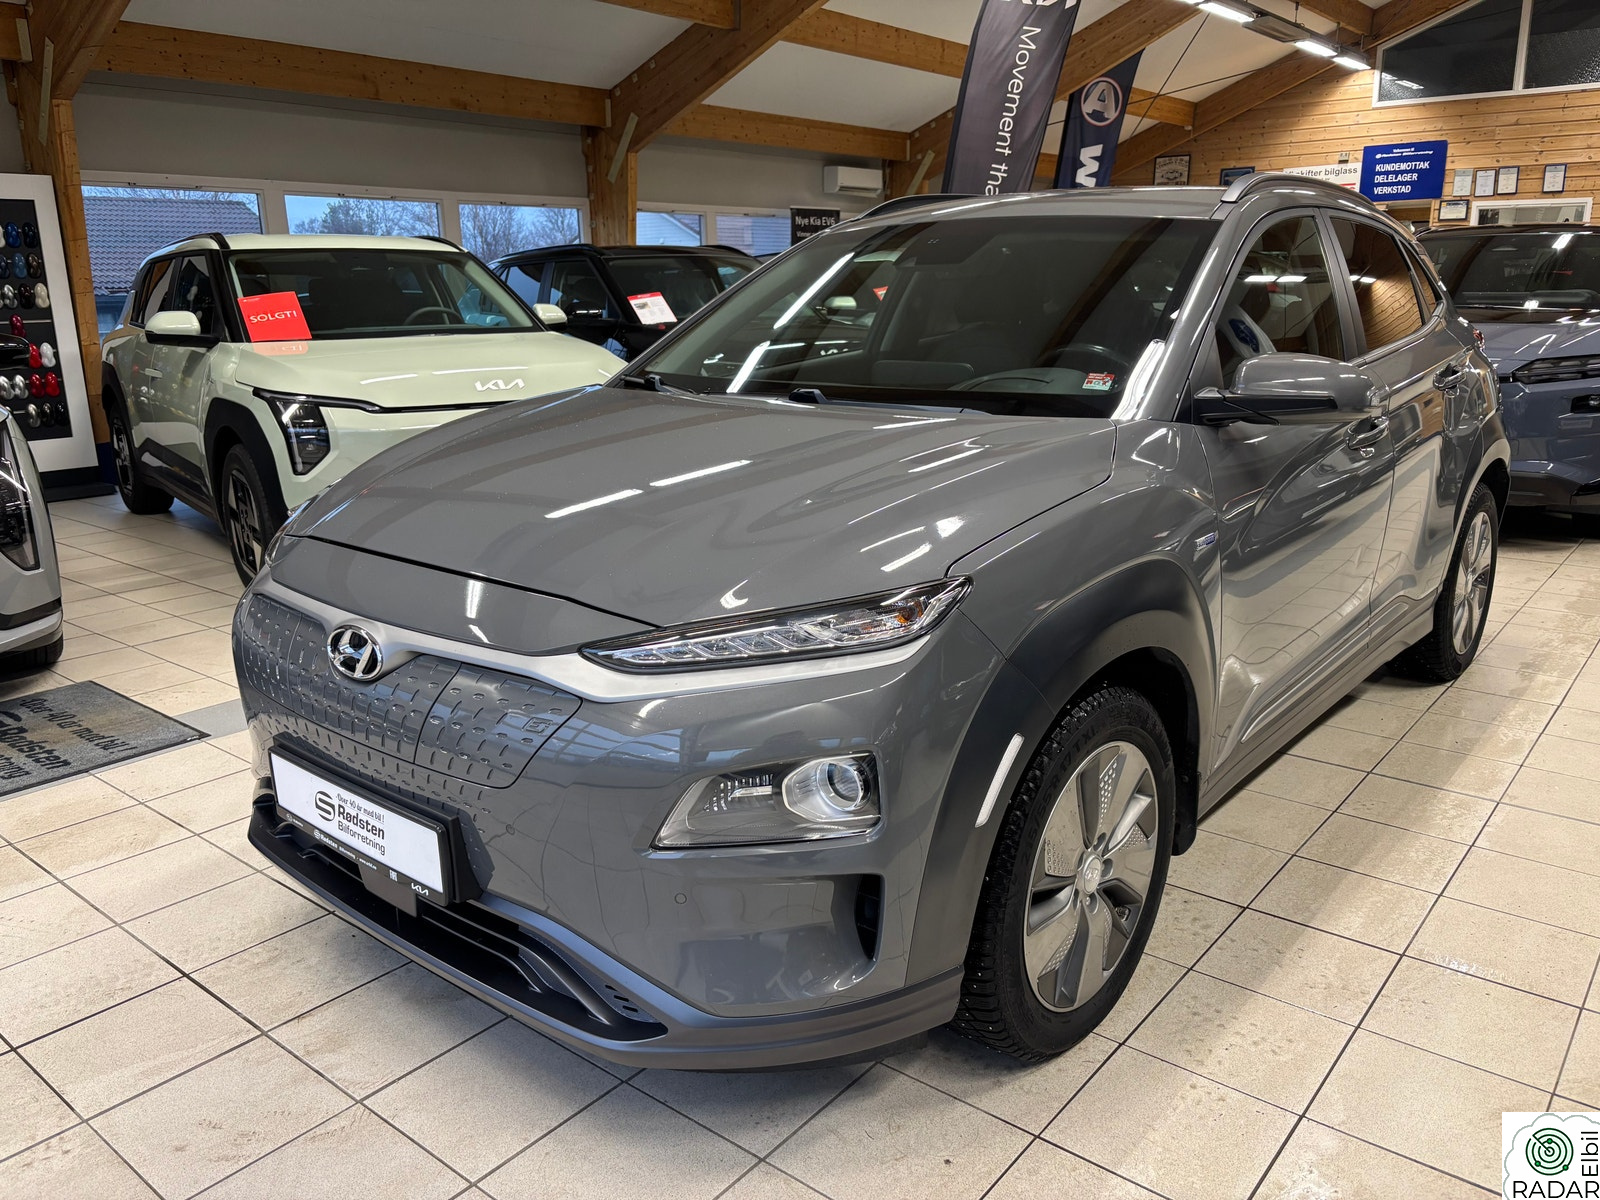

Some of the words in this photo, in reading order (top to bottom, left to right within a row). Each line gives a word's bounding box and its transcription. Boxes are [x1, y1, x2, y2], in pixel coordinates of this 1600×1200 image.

[995, 26, 1042, 156] Movement
[1324, 167, 1358, 177] bilglass
[1375, 161, 1430, 172] KUNDEMOTTAK
[1374, 173, 1418, 183] DELELAGER
[1373, 185, 1411, 195] VERKSTAD
[795, 216, 809, 228] Nye
[810, 216, 821, 226] Kia
[822, 217, 836, 226] EV6
[474, 378, 526, 392] KIA
[338, 804, 385, 840] Rødsten
[338, 820, 386, 856] Bilforretning
